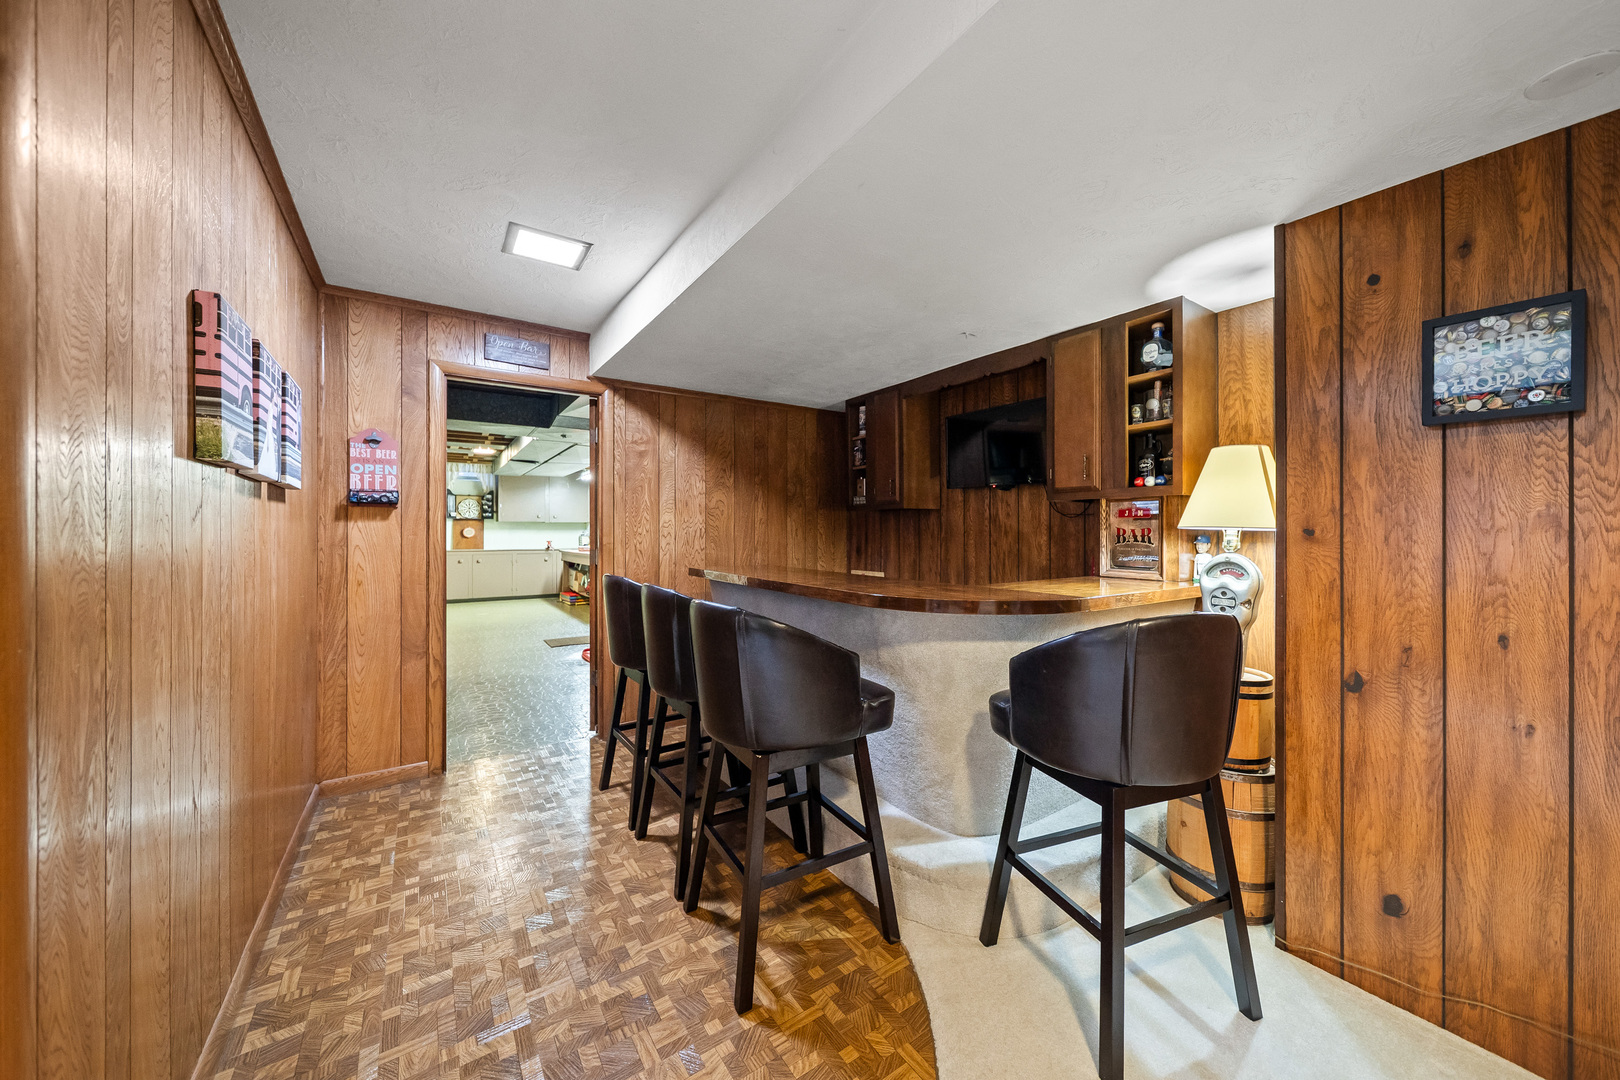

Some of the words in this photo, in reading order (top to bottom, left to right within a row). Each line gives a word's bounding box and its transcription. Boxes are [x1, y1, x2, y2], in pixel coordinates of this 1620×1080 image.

[490, 335, 514, 349] Open
[519, 341, 542, 355] Bar
[1454, 330, 1548, 362] BEER
[1450, 366, 1548, 394] HOPPY
[350, 448, 371, 458] BEST
[376, 448, 397, 460] BEER
[350, 463, 397, 475] OPEN
[350, 473, 397, 491] BEER
[1124, 507, 1144, 517] JIM
[1115, 527, 1155, 547] BAR
